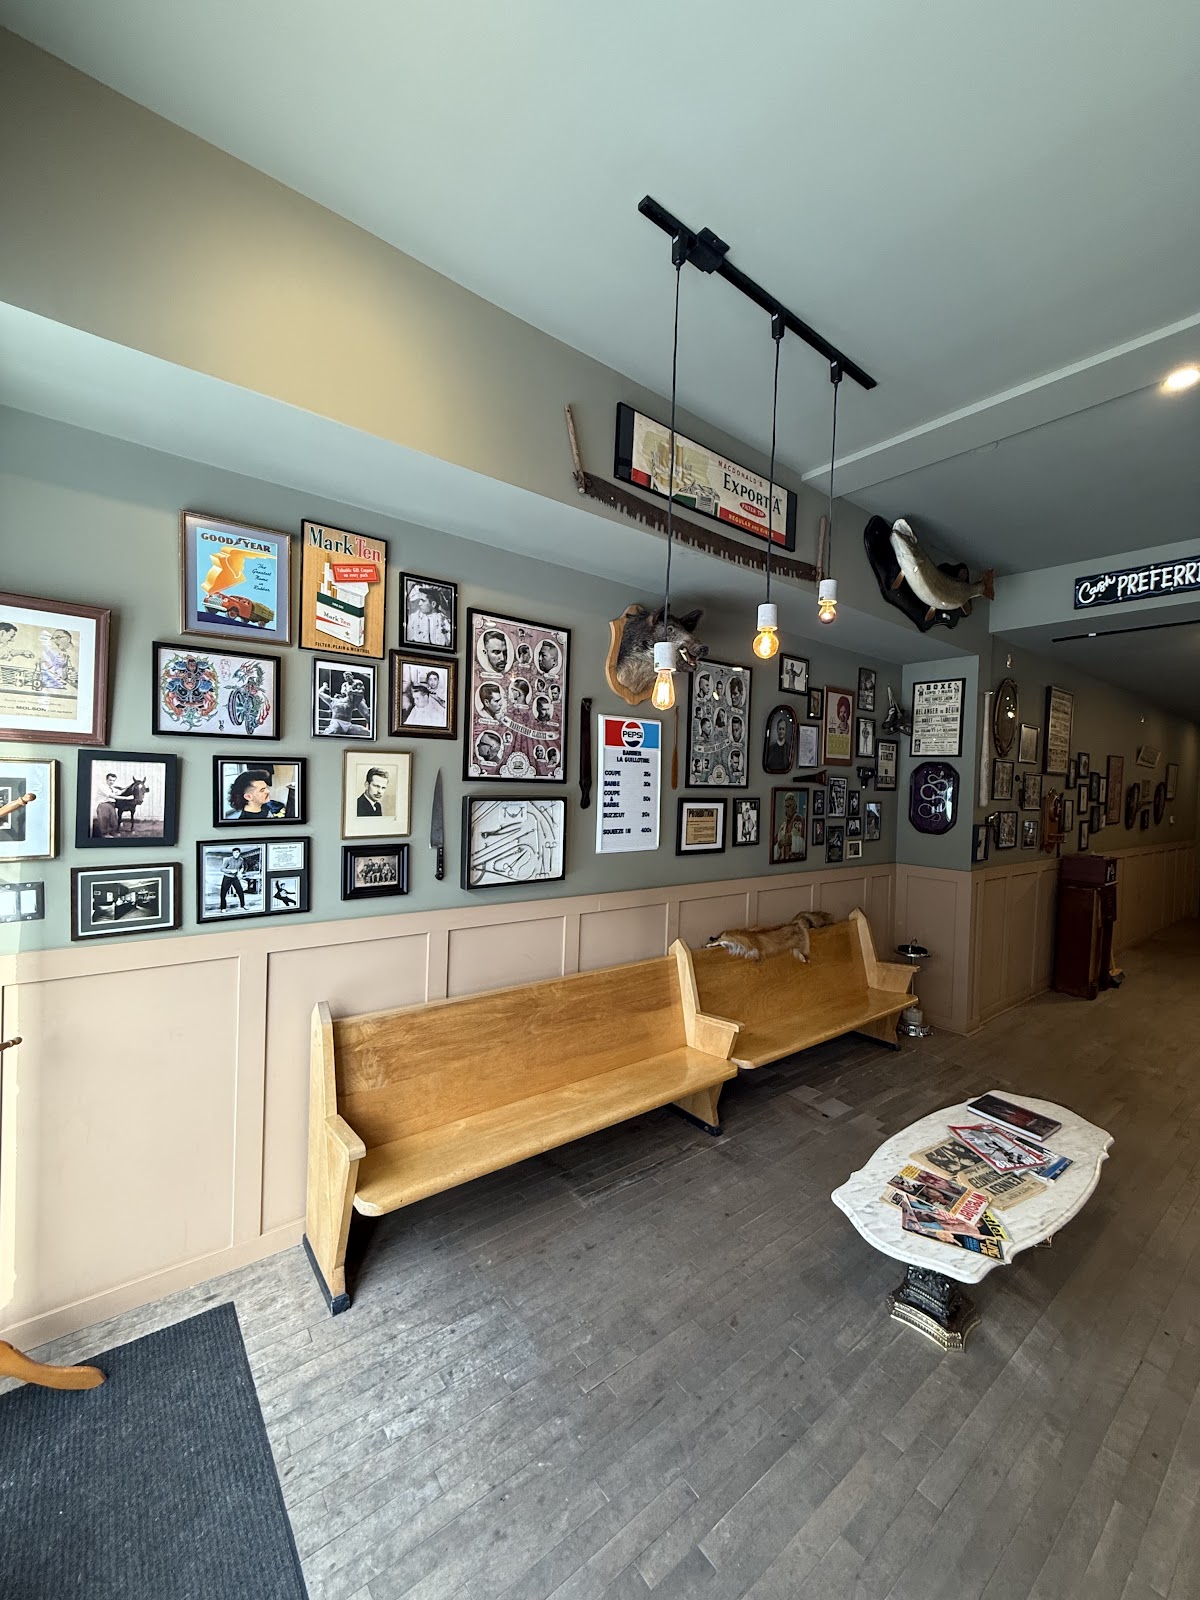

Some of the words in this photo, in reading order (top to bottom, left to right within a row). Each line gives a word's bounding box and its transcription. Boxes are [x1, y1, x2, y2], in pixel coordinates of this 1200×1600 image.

[718, 460, 763, 488] MACDONALD'S
[723, 472, 770, 508] EXPORT
[728, 514, 751, 528] REGULAR
[308, 526, 354, 556] Mark
[356, 537, 382, 562] Ten
[1078, 575, 1116, 604] Cash
[1117, 562, 1200, 596] PREFERR
[323, 611, 339, 622] Mark
[340, 617, 351, 627] Ten
[622, 730, 643, 739] PEPSI
[985, 1174, 1027, 1196] KENNEDY
